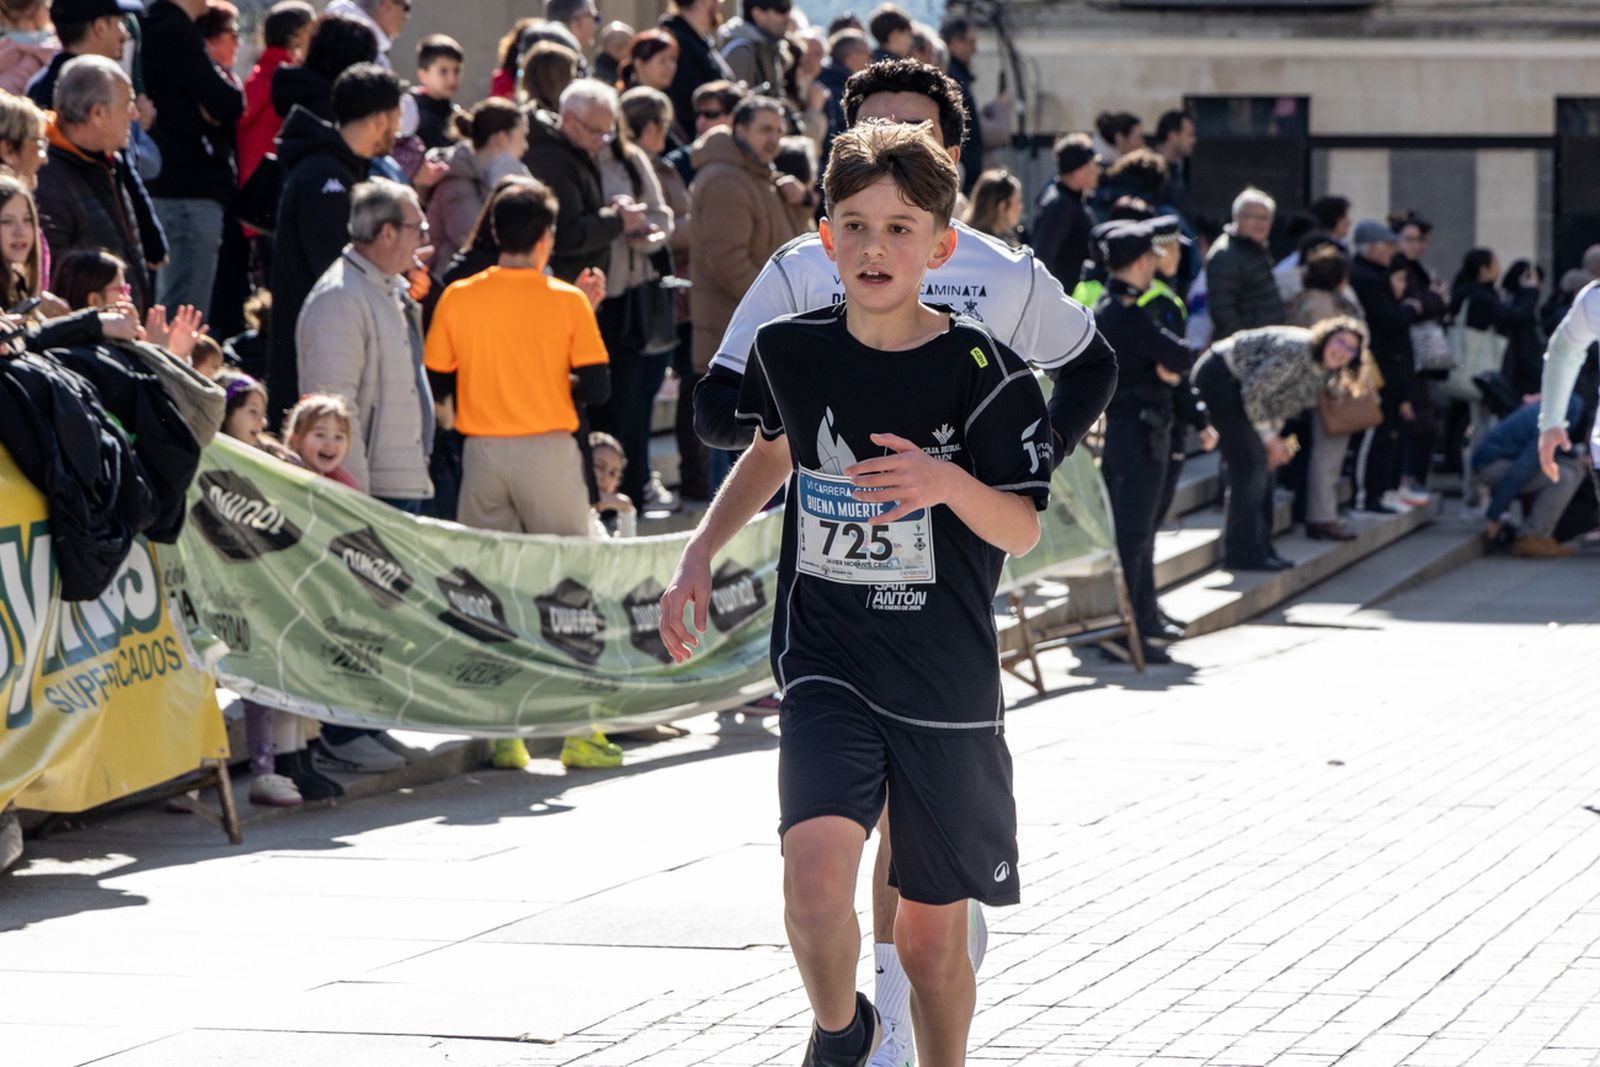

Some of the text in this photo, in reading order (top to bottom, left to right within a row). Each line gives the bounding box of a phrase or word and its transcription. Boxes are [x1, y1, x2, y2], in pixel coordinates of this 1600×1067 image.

[807, 480, 814, 489] VI
[814, 482, 852, 497] CARRERA
[806, 494, 885, 518] BUENA MUERTE
[819, 520, 893, 561] 725
[872, 588, 927, 605] ANTÓN
